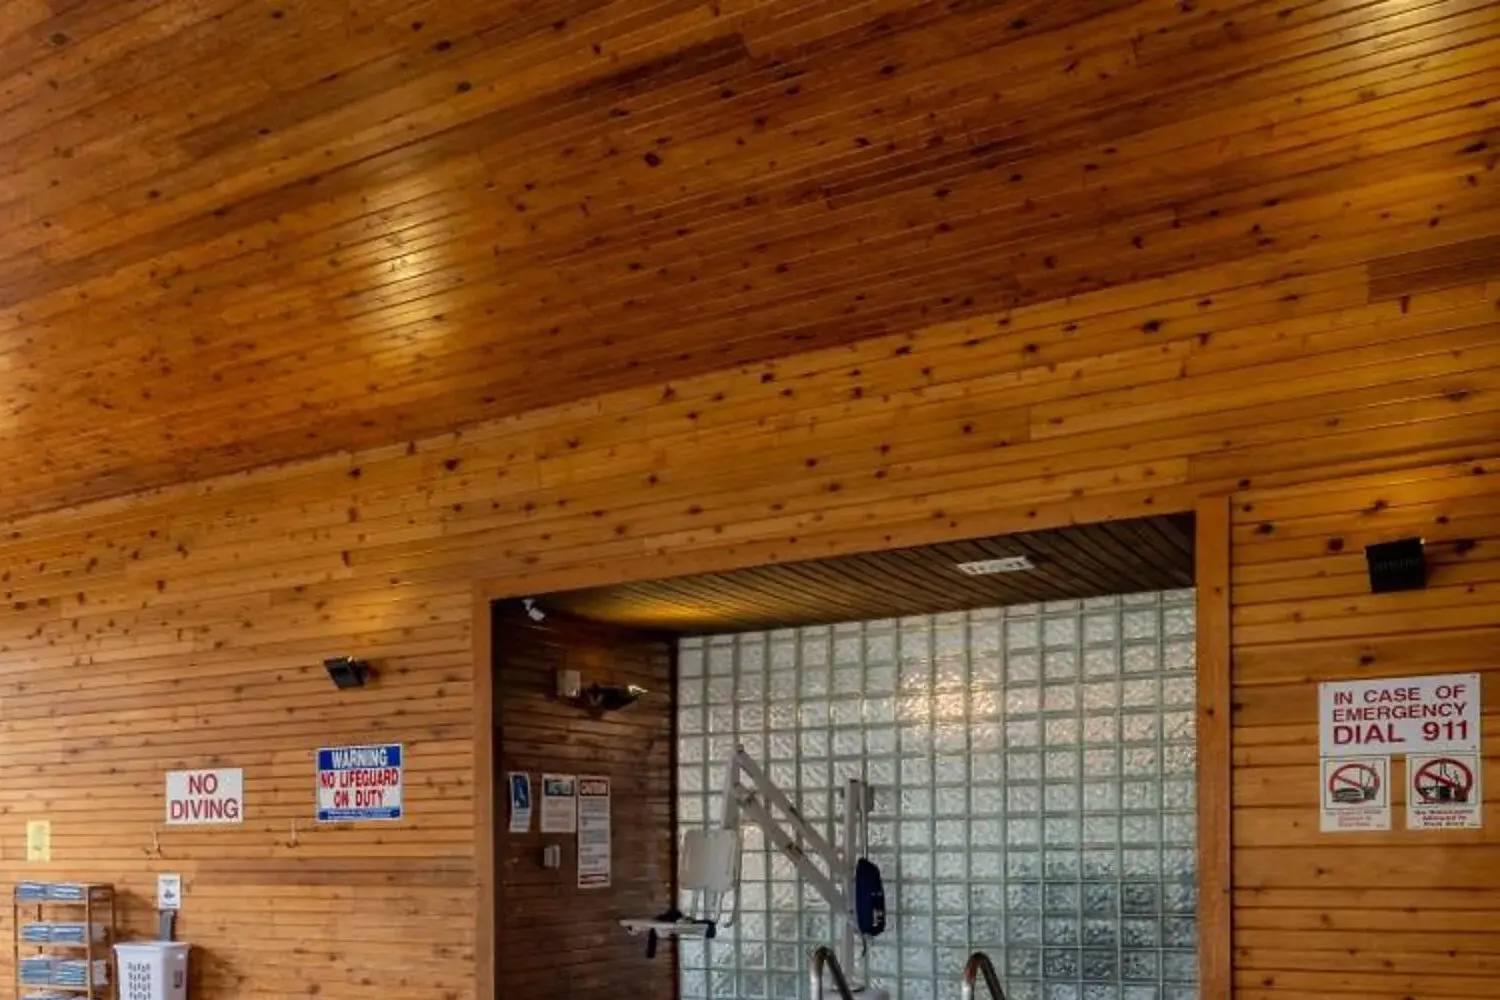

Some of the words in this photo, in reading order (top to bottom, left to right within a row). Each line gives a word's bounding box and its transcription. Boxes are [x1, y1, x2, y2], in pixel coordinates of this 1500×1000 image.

[1333, 690, 1354, 705] IN
[1362, 687, 1422, 703] CASE
[1434, 684, 1467, 699] OF
[1332, 701, 1468, 723] EMERGENCY
[1333, 723, 1406, 745] DIAL
[1422, 719, 1468, 741] 911
[331, 747, 389, 769] WARNING
[189, 773, 218, 795] NO
[321, 771, 335, 788] NO
[339, 768, 399, 788] LIFEGUARD
[171, 797, 239, 820] DIVING
[334, 791, 349, 807] ON
[355, 789, 384, 807] DUTY
